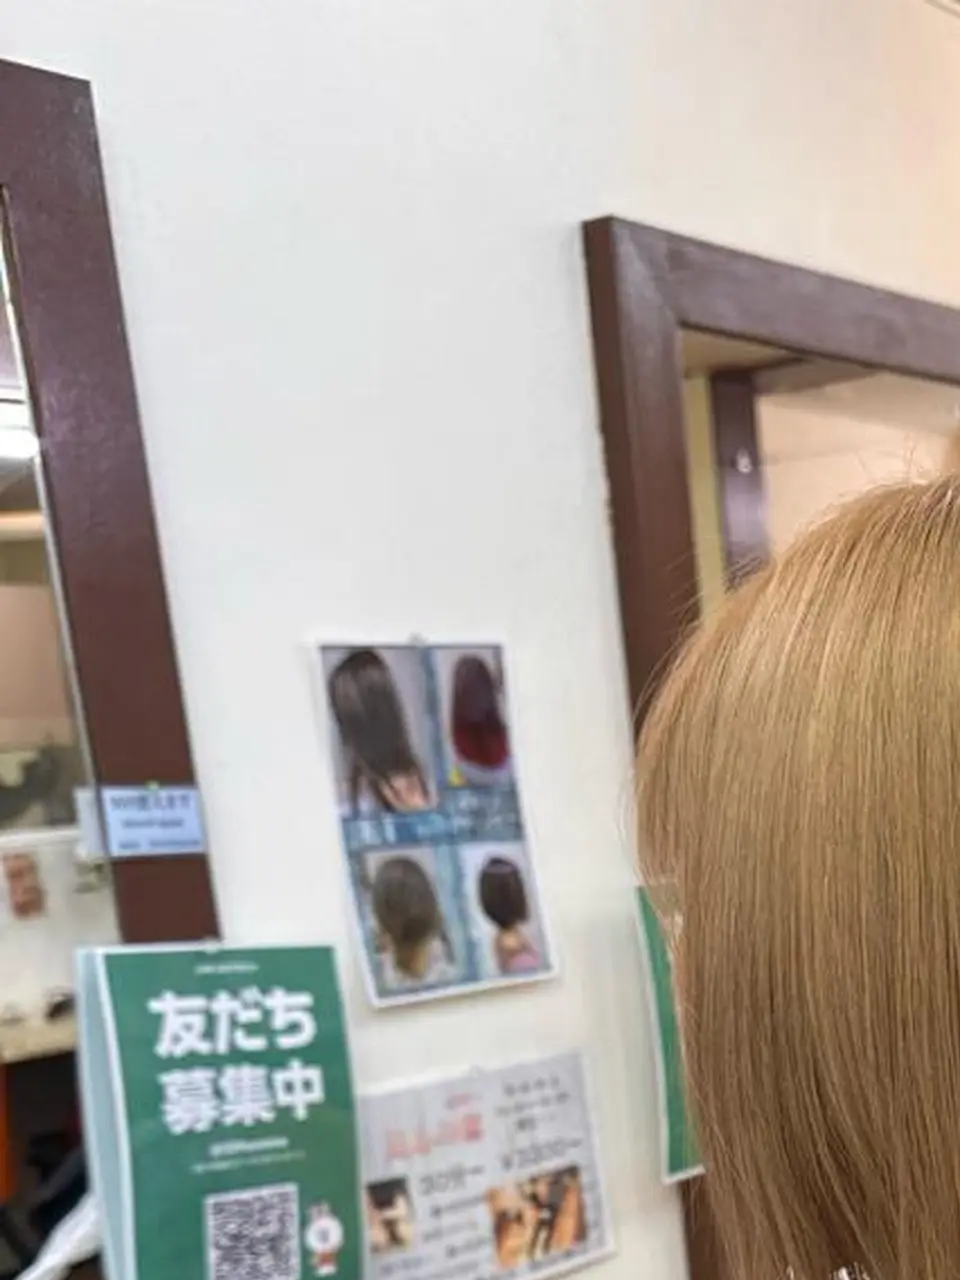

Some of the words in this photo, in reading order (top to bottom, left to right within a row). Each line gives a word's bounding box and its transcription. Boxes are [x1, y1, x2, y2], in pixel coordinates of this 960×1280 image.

[147, 986, 316, 1057] 友だち
[158, 1058, 324, 1134] 募集中
